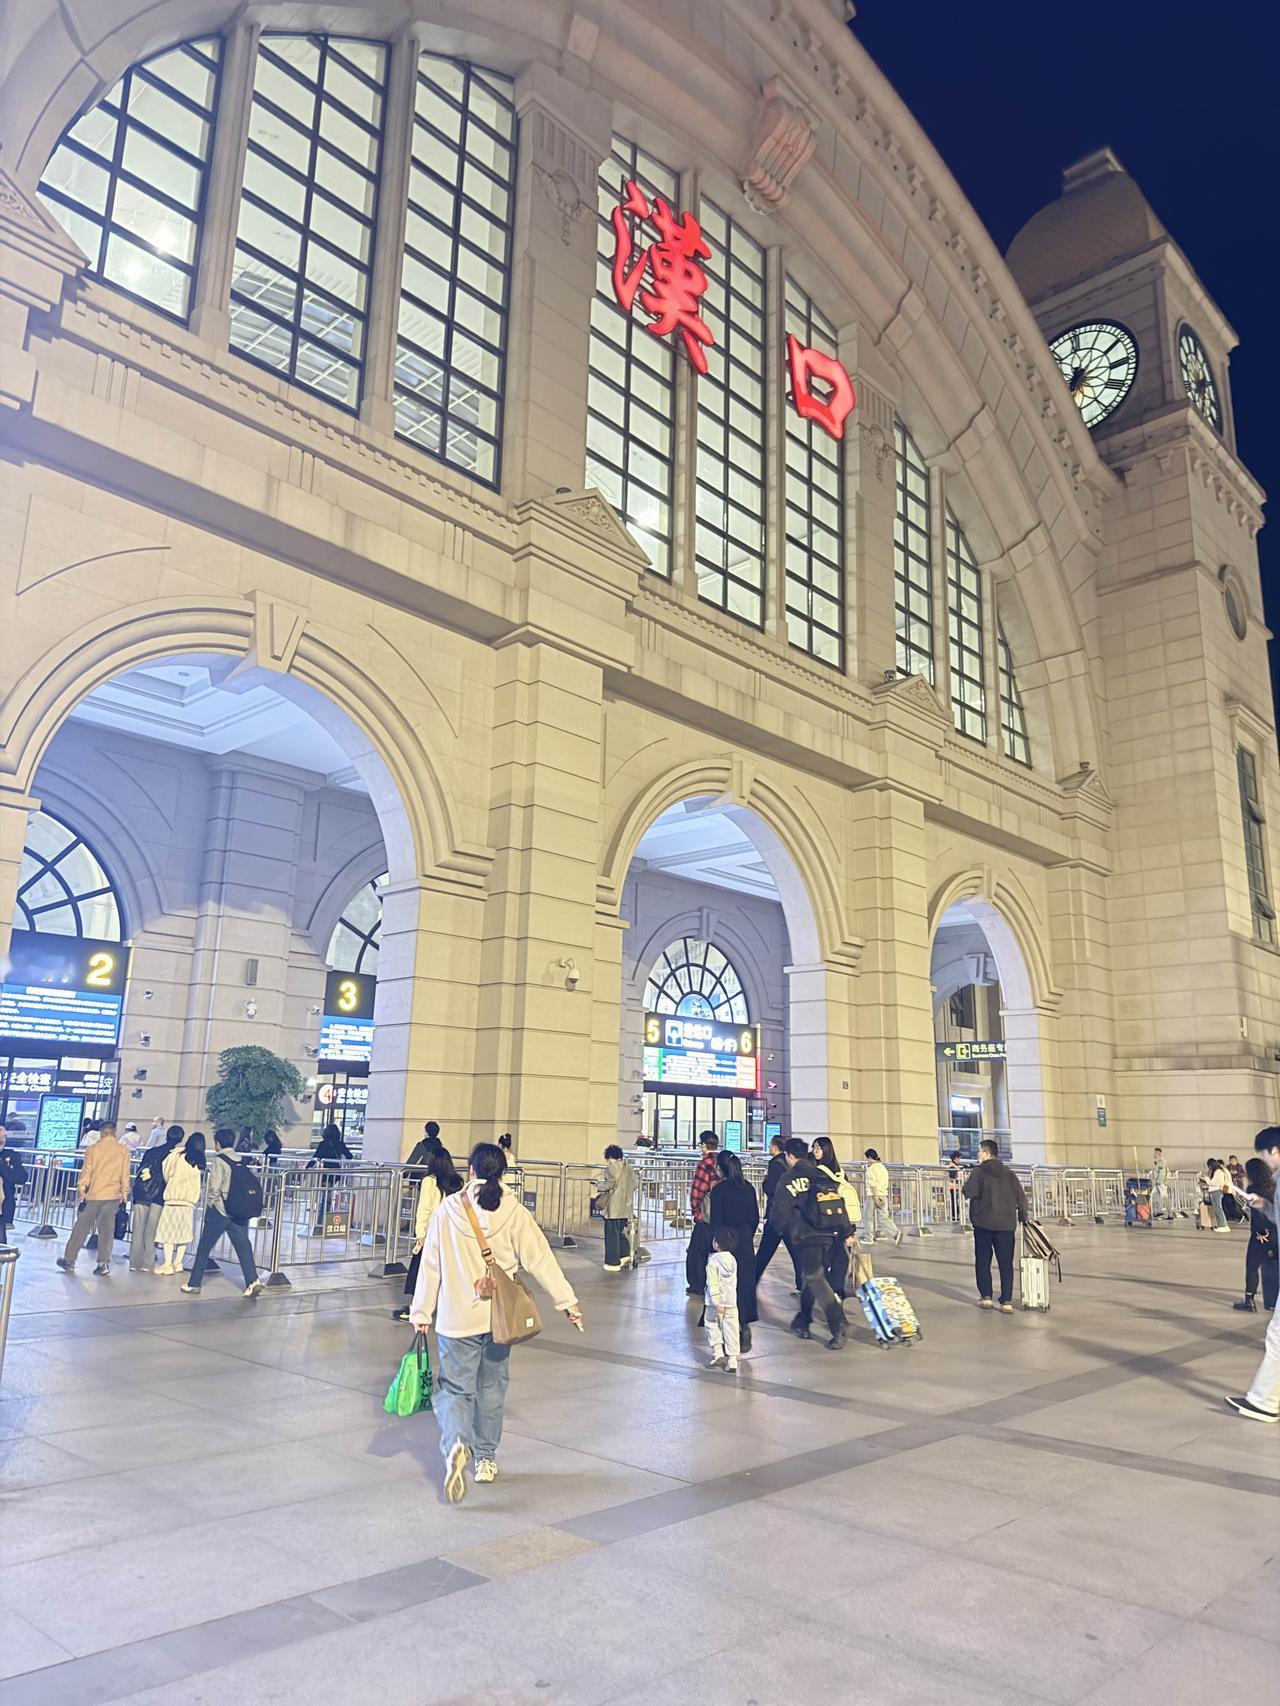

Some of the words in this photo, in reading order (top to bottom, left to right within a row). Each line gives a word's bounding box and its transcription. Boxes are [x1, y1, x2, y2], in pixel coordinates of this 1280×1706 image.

[86, 953, 115, 986] 2
[338, 981, 357, 1011] 3
[646, 1019, 660, 1043] 5
[740, 1032, 752, 1053] 6
